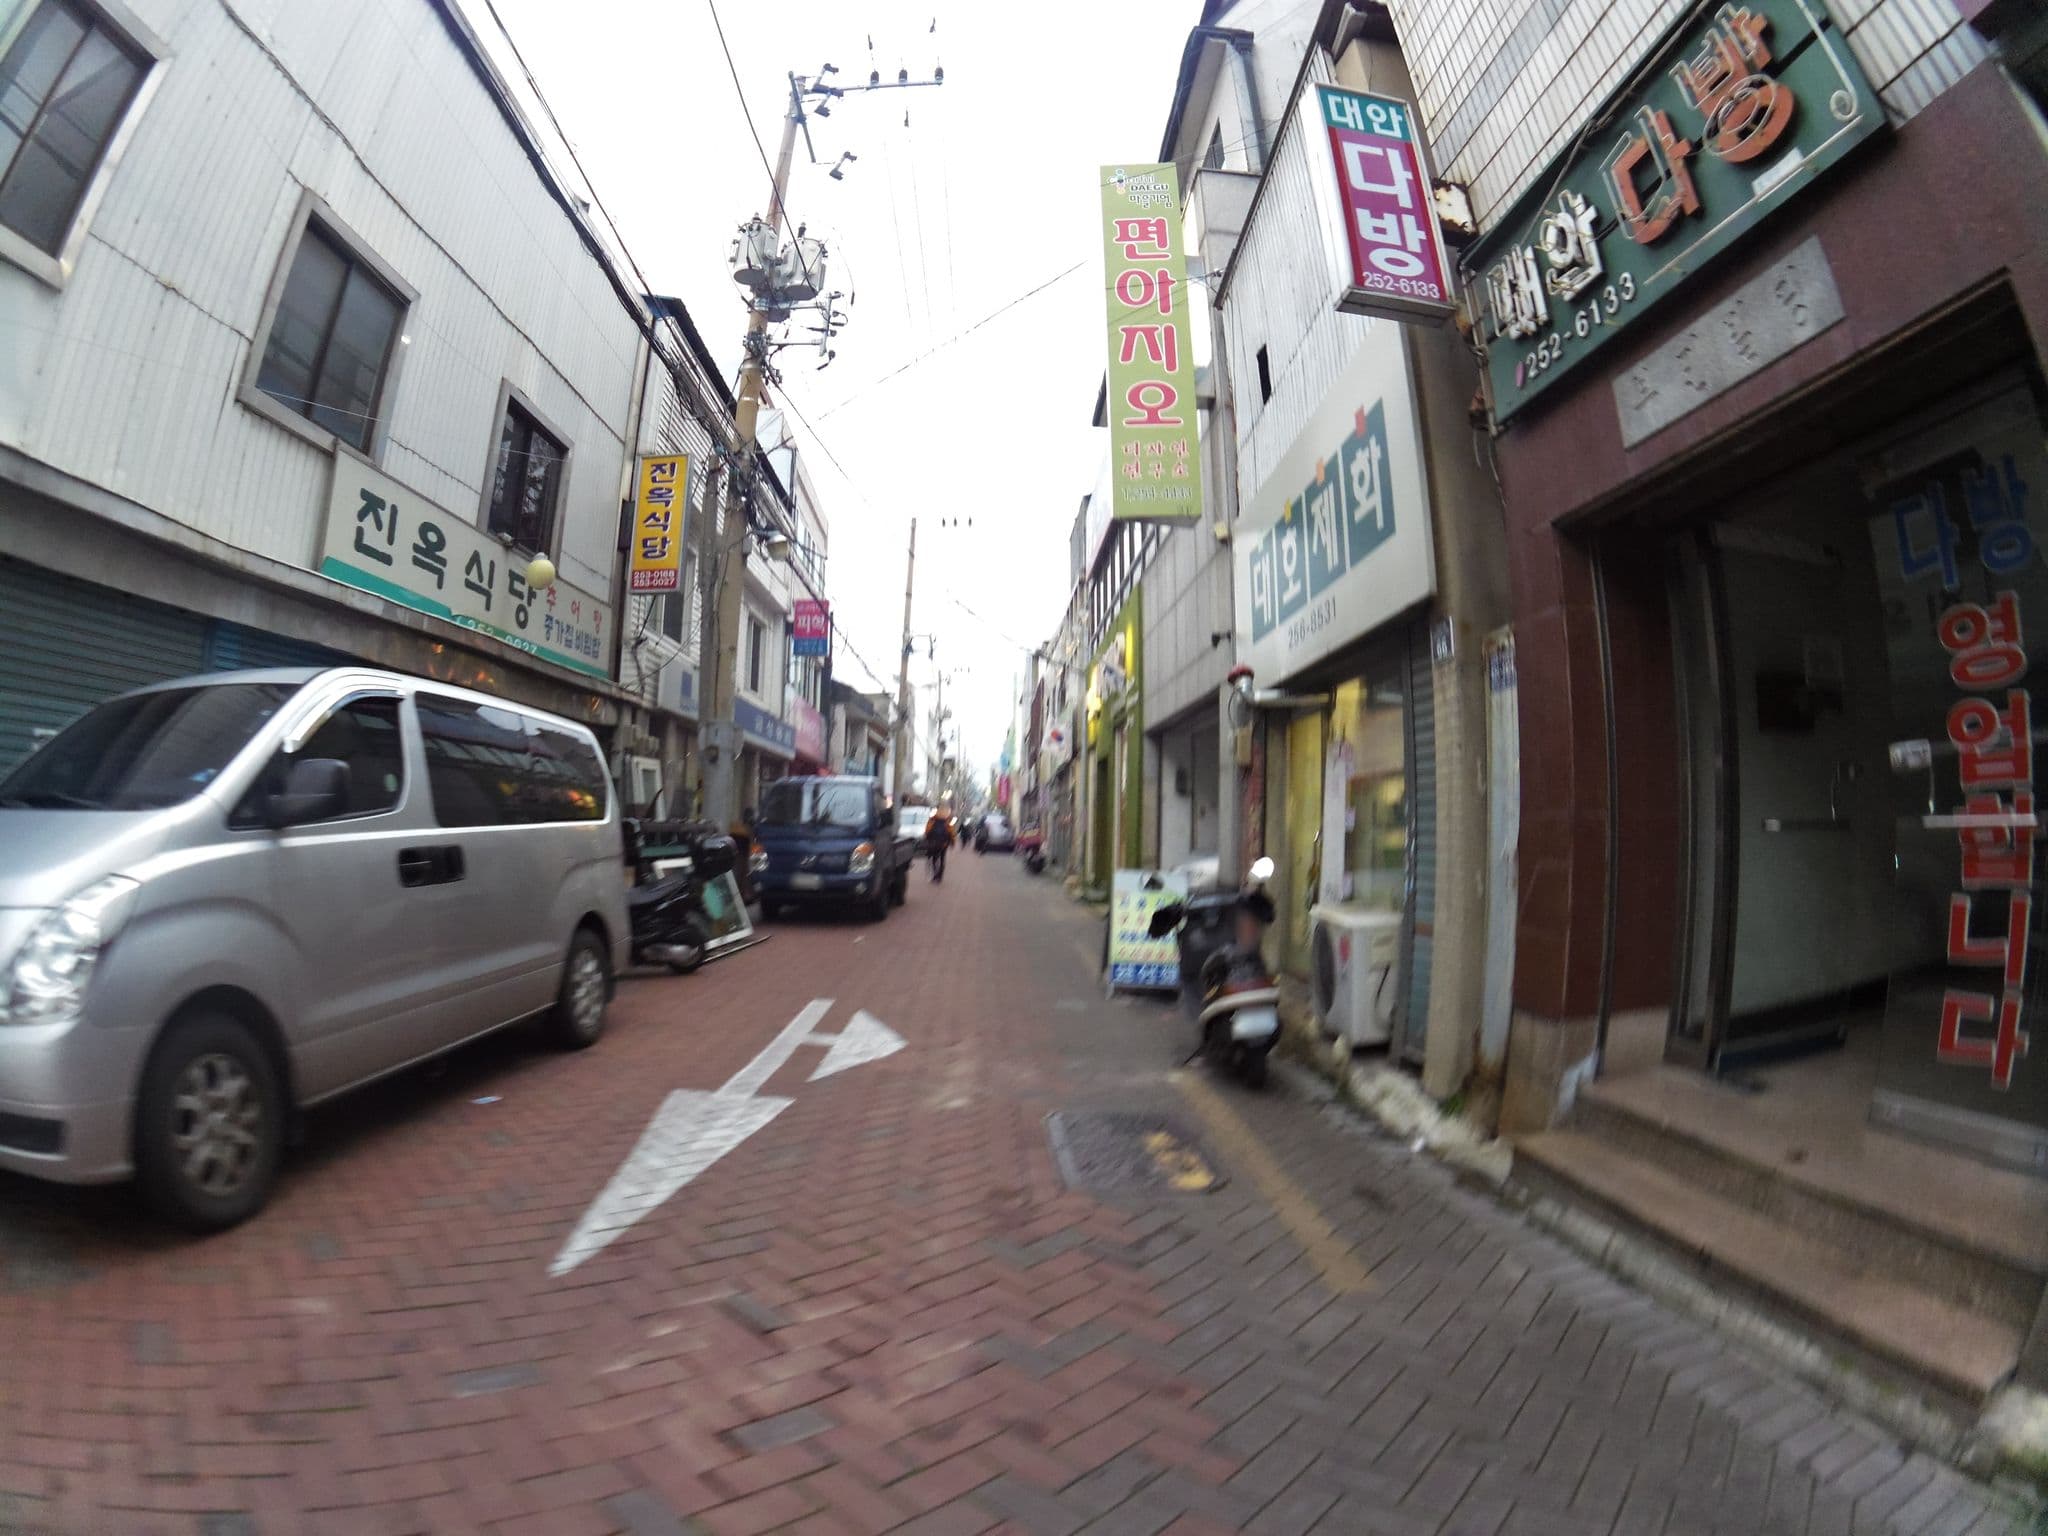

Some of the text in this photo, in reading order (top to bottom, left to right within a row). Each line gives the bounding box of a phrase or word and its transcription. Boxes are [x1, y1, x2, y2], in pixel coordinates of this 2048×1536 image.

[1328, 94, 1403, 138] 대안
[1129, 193, 1172, 209] 마을기업
[1130, 183, 1169, 192] DAEGU
[1342, 141, 1427, 277] 다방
[1486, 188, 1604, 340] 대안
[1600, 3, 1795, 244] 다방
[1362, 271, 1440, 299] 252-6133
[1525, 271, 1636, 379] 252-6133
[354, 487, 537, 630] 진옥식당
[641, 462, 678, 560] 진옥식당
[1251, 436, 1384, 627] 대호제화
[1892, 453, 2032, 592] 다방
